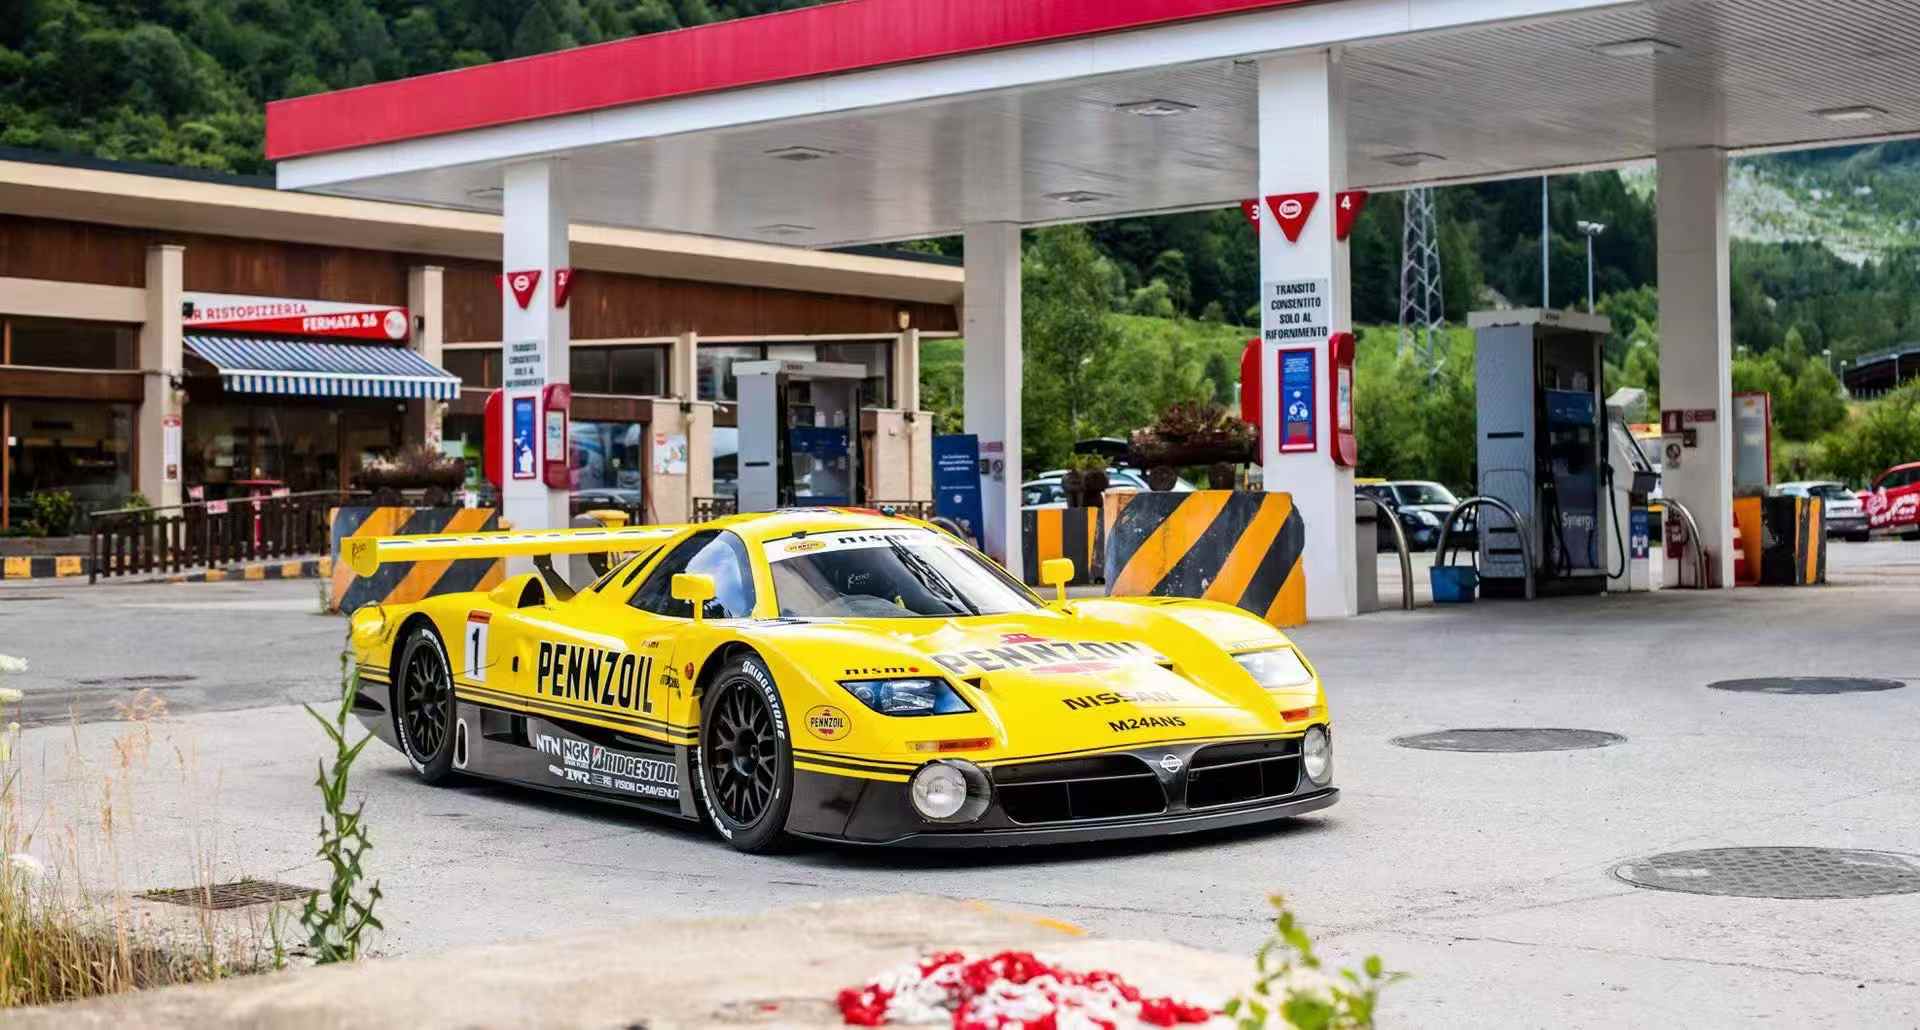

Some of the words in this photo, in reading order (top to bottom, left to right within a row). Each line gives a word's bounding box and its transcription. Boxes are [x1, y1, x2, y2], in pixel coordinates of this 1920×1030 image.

[1341, 196, 1351, 210] 4
[1251, 205, 1260, 220] 3
[1276, 283, 1315, 295] TRANSITO
[207, 303, 307, 319] RISTOPIZZERIA
[1271, 298, 1321, 310] CONSENTITO
[303, 315, 359, 331] FERMATA
[362, 313, 378, 328] 26
[1279, 313, 1300, 324] SOLO
[1303, 312, 1312, 323] AL
[1265, 326, 1328, 340] RIFORNIMENTO
[472, 628, 480, 675] 1
[538, 642, 653, 713] PENNZOIL
[742, 660, 785, 740] BRIDGESTONE
[1062, 690, 1180, 710] NISSAN
[810, 716, 844, 728] PENNZOIL
[1108, 716, 1187, 732] M24ANS
[536, 734, 561, 756] NTN
[563, 740, 590, 763] NGK
[592, 746, 679, 784] BRIDGESTON
[564, 767, 591, 784] TWR
